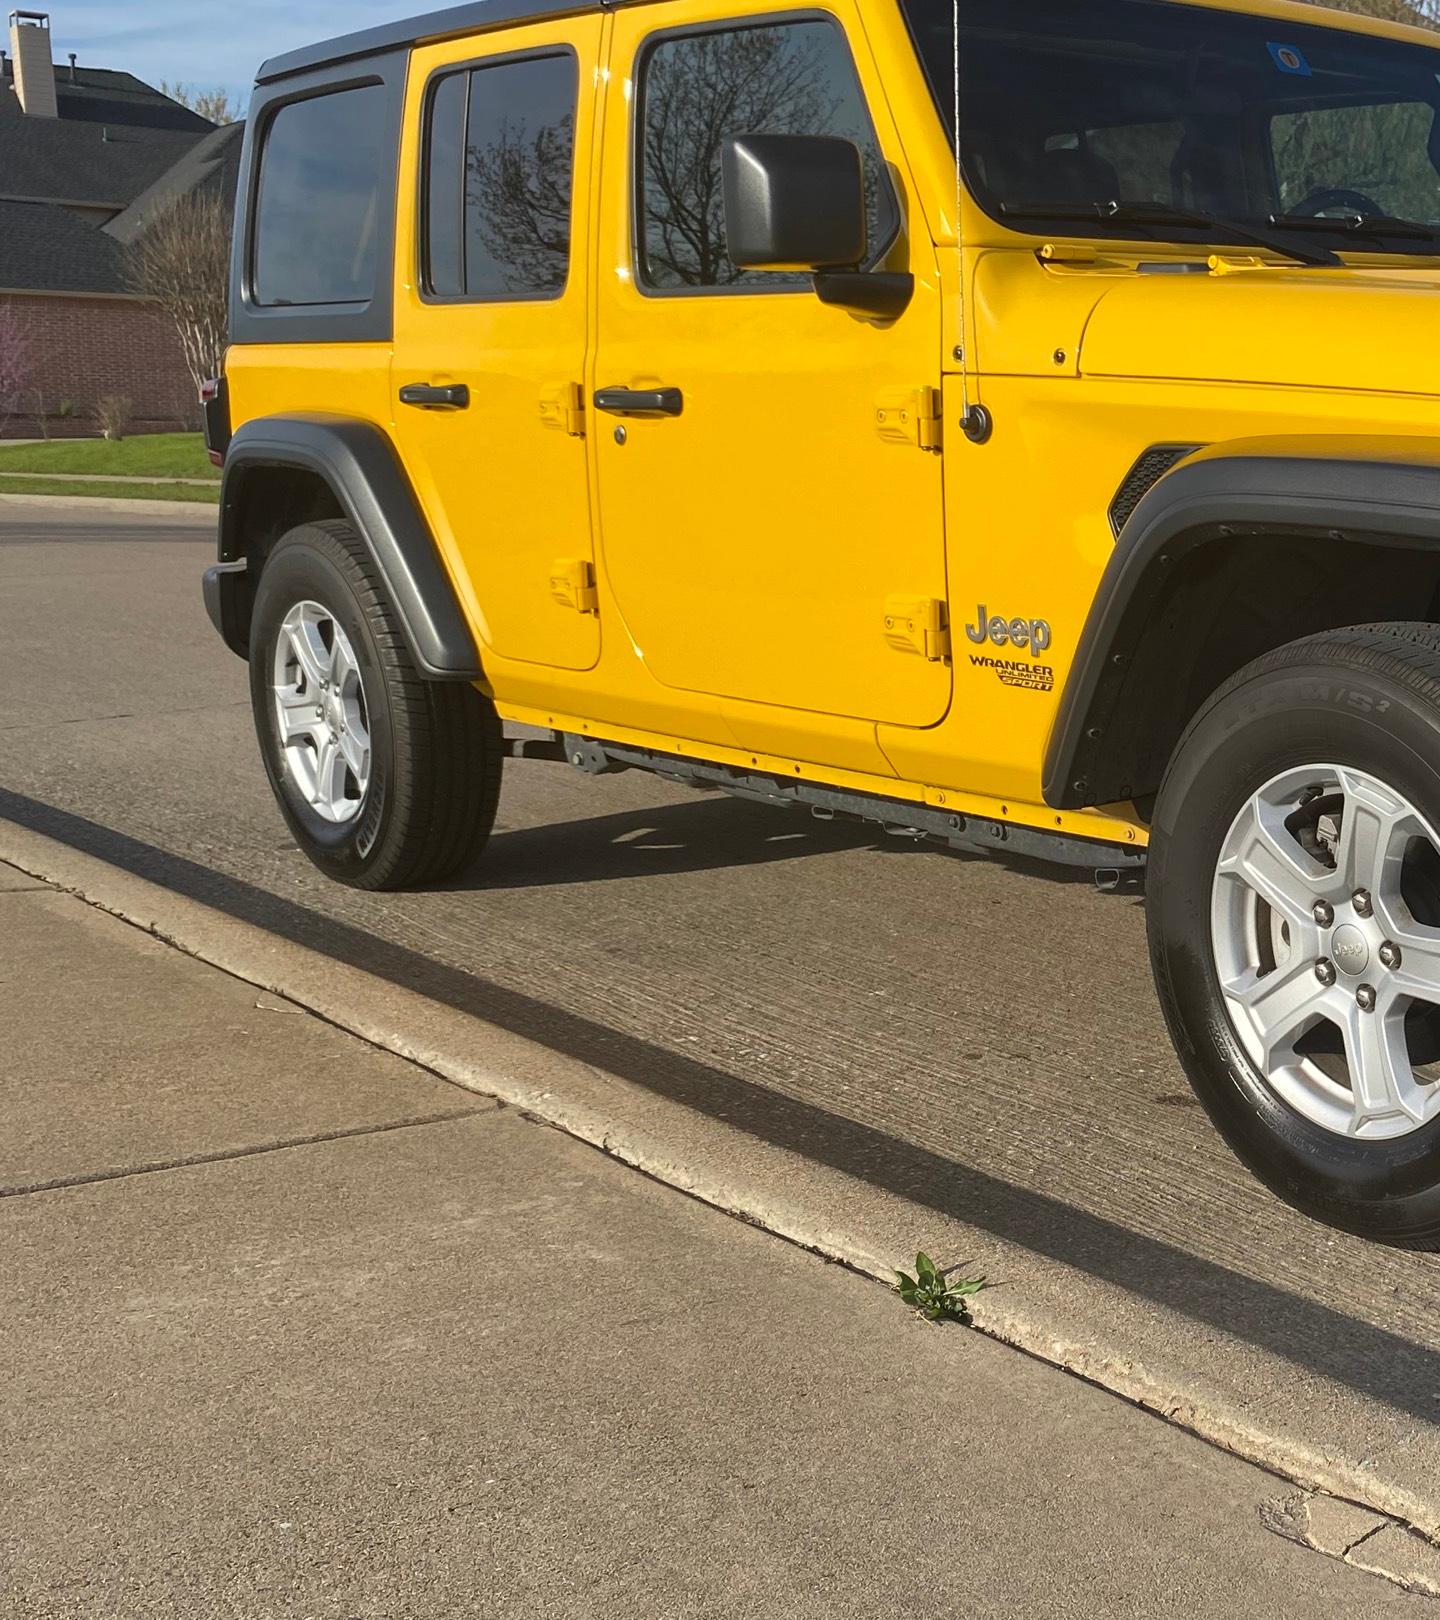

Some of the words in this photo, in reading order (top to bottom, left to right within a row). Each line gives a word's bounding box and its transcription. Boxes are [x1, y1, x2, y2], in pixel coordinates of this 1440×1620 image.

[966, 604, 1051, 657] Jeep
[969, 654, 1053, 677] WRANGLER
[996, 668, 1054, 682] UNLIMITED
[1001, 677, 1053, 691] SPORT
[1333, 942, 1363, 957] Jeep
